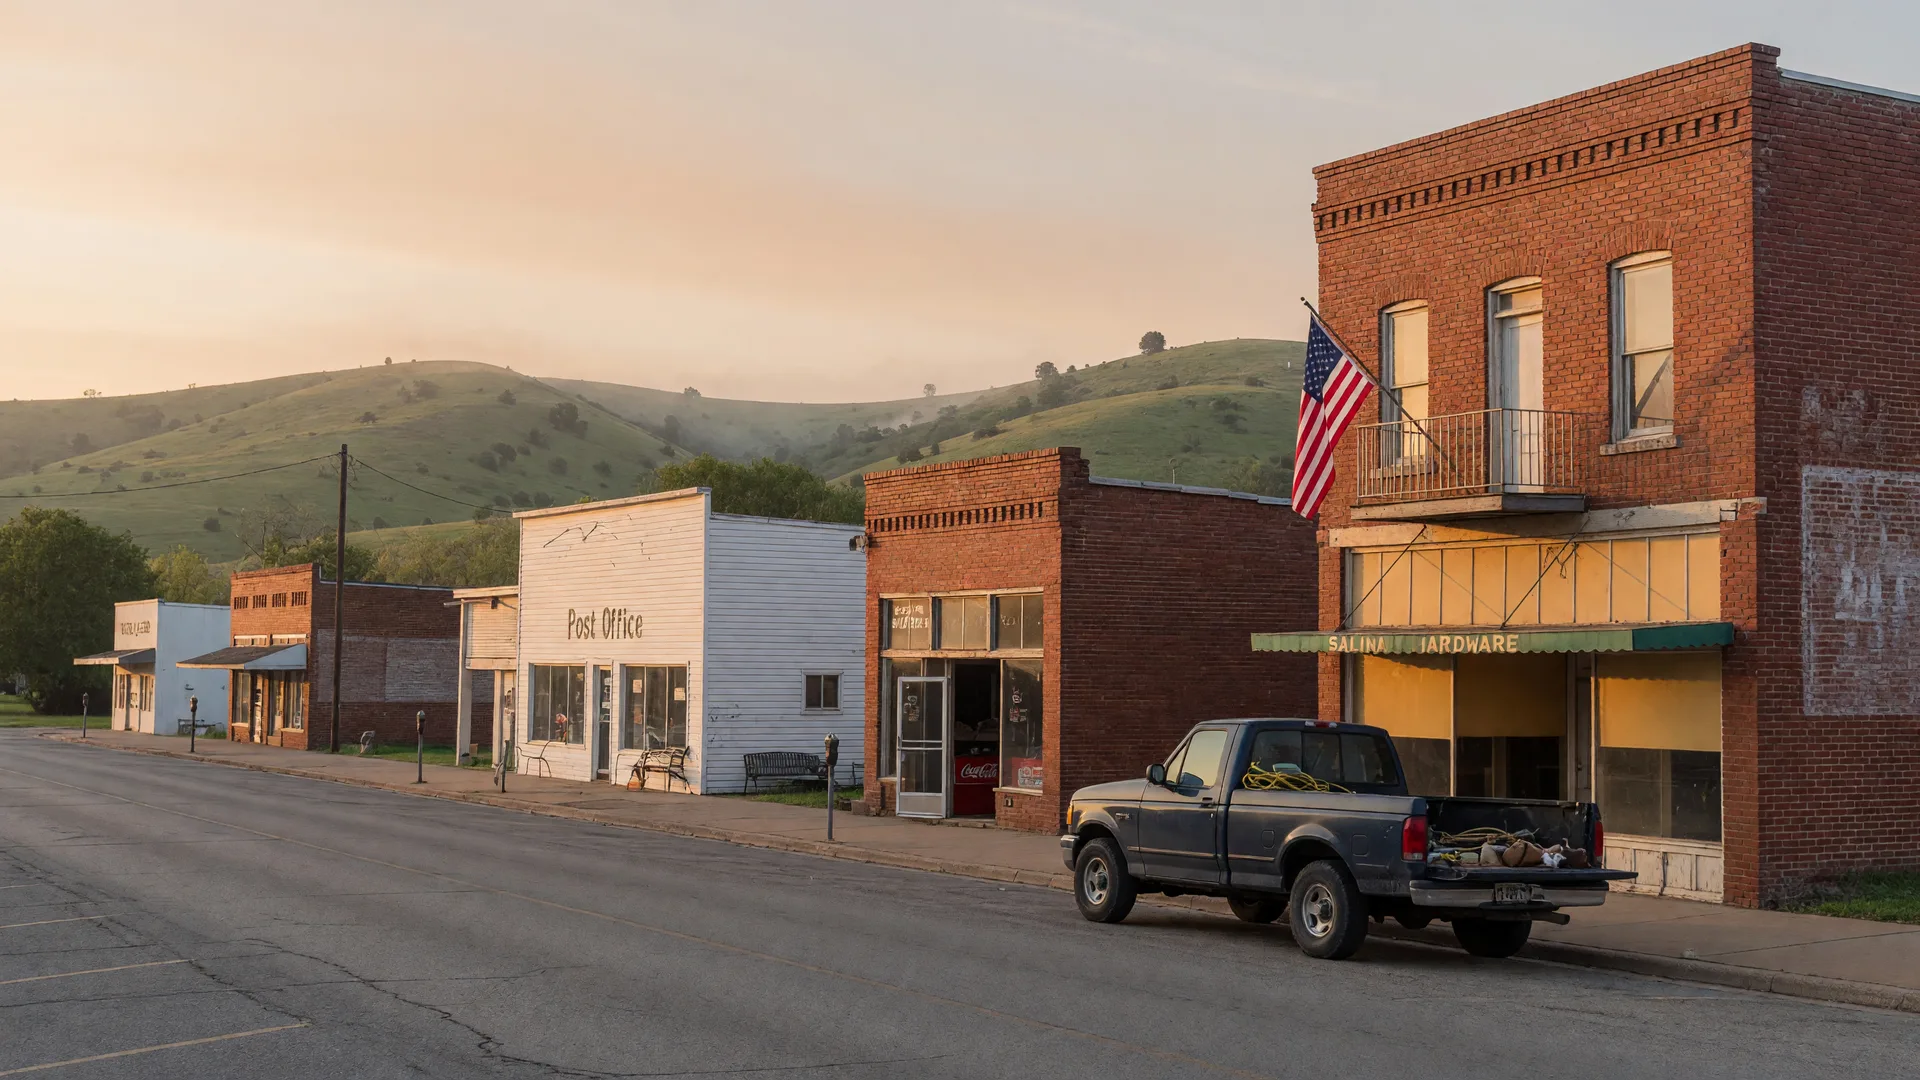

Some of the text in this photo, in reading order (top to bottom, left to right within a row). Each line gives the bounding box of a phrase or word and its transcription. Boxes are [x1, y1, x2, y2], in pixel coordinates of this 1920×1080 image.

[568, 606, 643, 640] Post Office
[1328, 635, 1386, 654] SALINA
